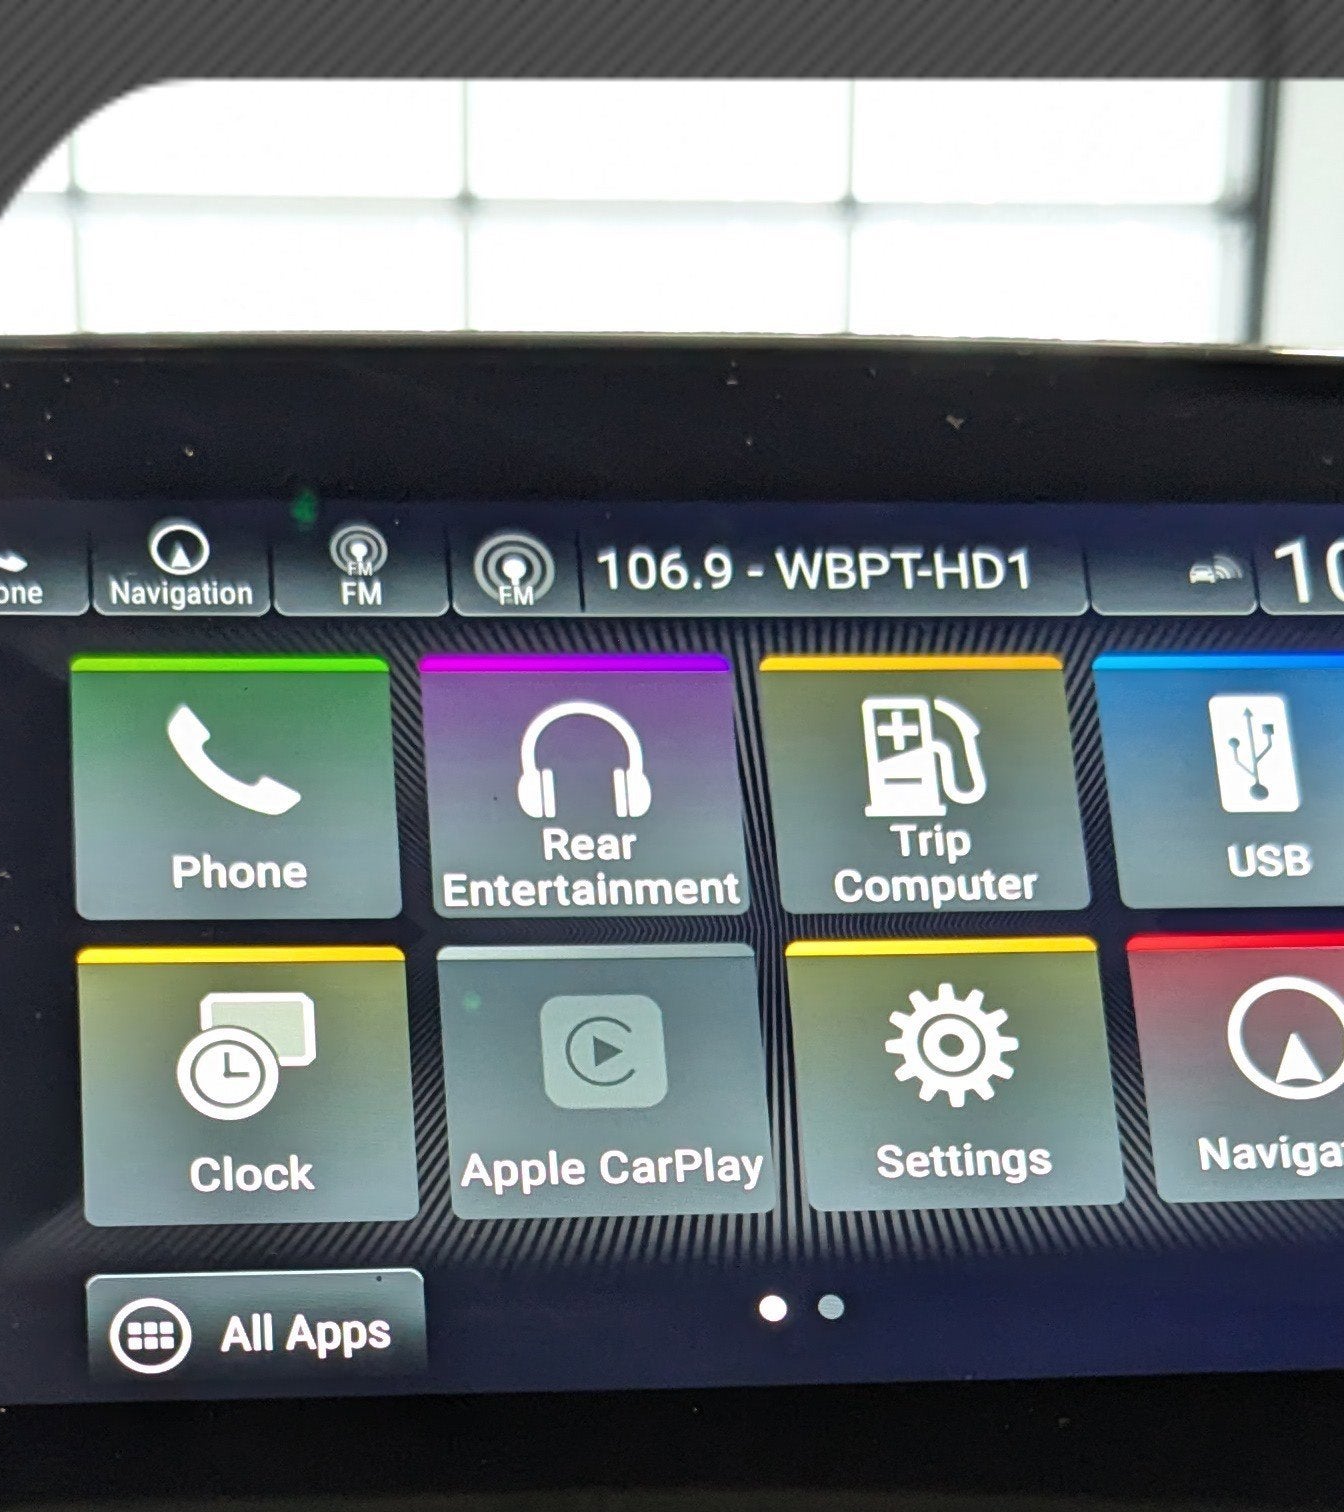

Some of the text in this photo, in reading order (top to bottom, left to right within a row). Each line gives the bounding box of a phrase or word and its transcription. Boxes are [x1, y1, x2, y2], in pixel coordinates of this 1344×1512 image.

[347, 561, 374, 577] FM
[597, 549, 733, 591] 106.9
[775, 550, 1032, 591] WBPT-HD1
[109, 580, 254, 610] Navigation
[341, 580, 383, 606] FM
[498, 585, 535, 606] FM
[542, 828, 637, 863] Rear
[889, 823, 973, 862] Trip
[1227, 844, 1313, 879] USB
[172, 853, 308, 890] Phone
[833, 869, 1038, 908] Computer
[442, 872, 740, 910] Entertainment
[188, 1153, 315, 1194] Clock
[461, 1147, 764, 1197] Apple CarPlay
[876, 1142, 1053, 1185] Settings
[220, 1312, 392, 1360] All Apps
